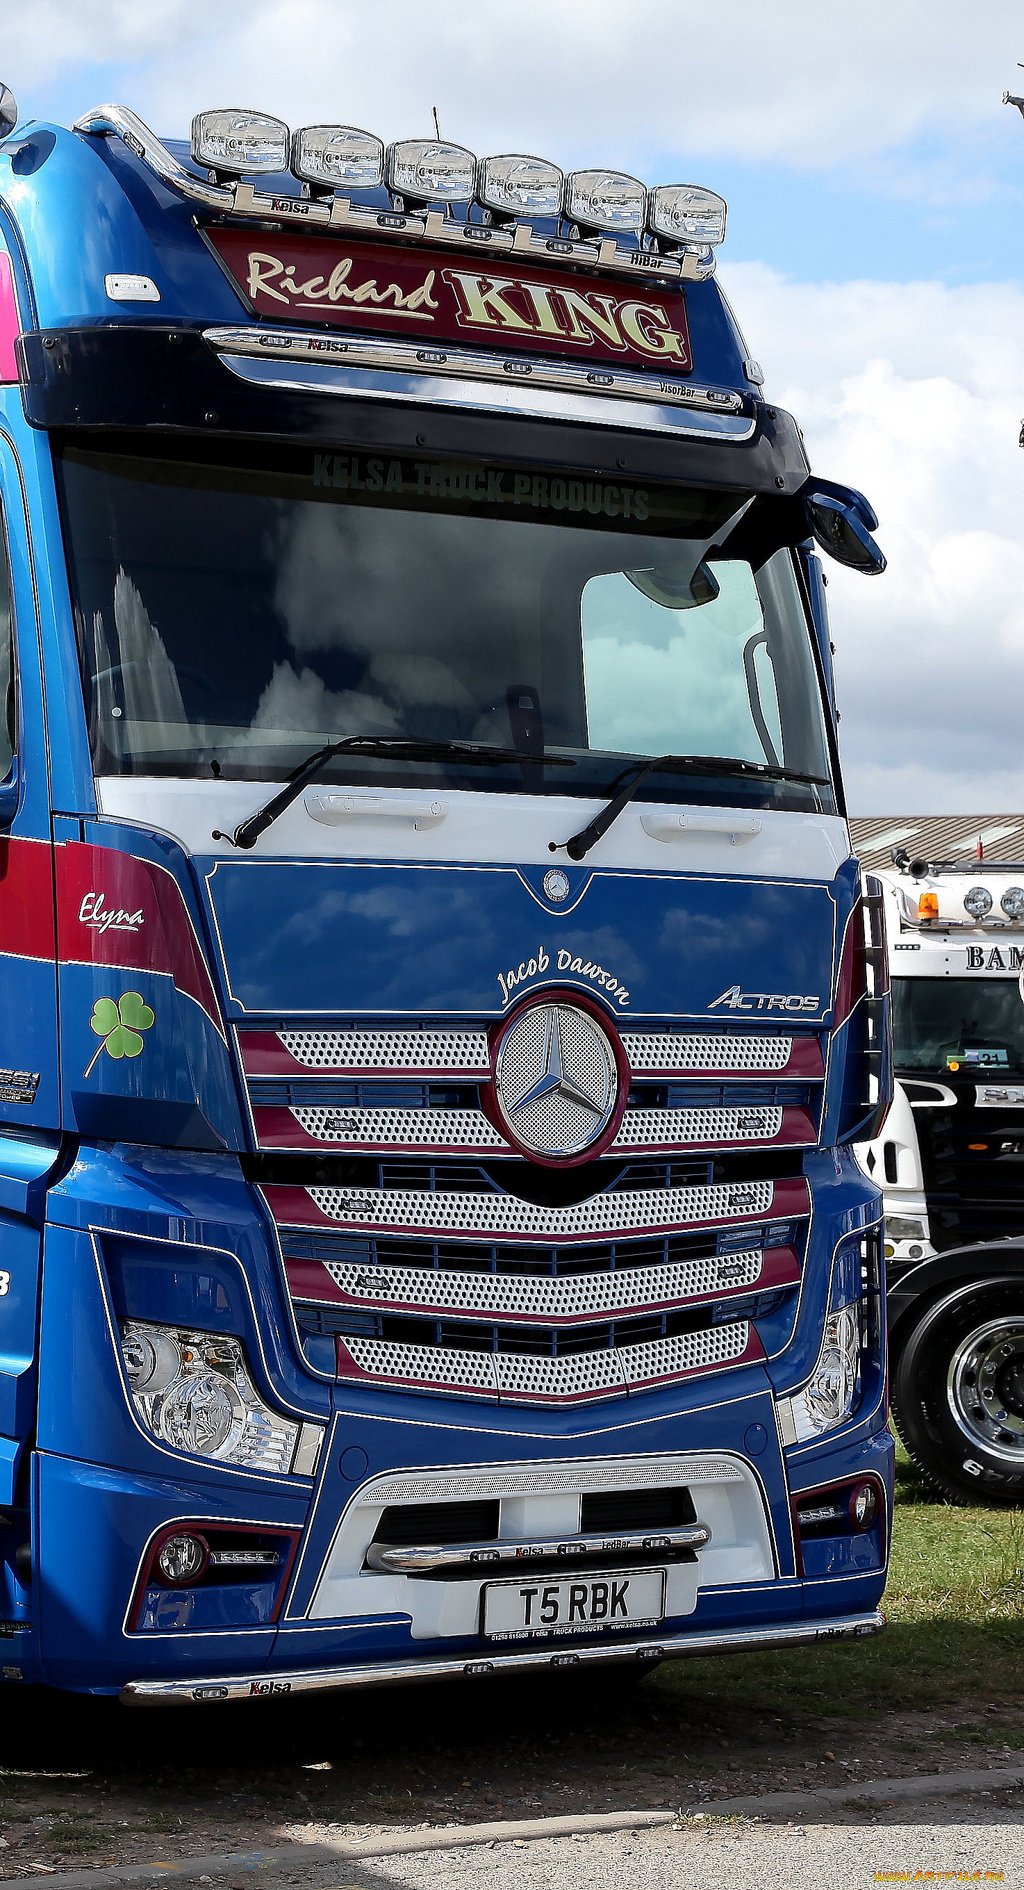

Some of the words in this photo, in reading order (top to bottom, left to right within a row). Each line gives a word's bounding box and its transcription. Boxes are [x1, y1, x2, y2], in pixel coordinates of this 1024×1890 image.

[270, 199, 310, 214] Kelsa
[630, 253, 663, 269] HiBar
[246, 251, 439, 309] Richard
[442, 268, 688, 364] KING
[307, 338, 348, 352] Kelsa
[659, 381, 695, 397] VisorBar
[313, 454, 403, 493] KELSA
[414, 463, 504, 503] TRUCK
[514, 474, 649, 521] PRODUCTS
[78, 892, 145, 933] Elyna
[495, 945, 550, 1005] Jacob
[556, 948, 631, 1006] Dawson
[515, 1547, 544, 1557] Kelsa
[601, 1539, 631, 1550] LedBar
[519, 1586, 560, 1626] T5
[569, 1580, 630, 1622] RBK
[553, 1628, 573, 1636] TRUCK
[573, 1625, 604, 1634] PRODUCTS
[249, 1681, 292, 1695] Kelsa
